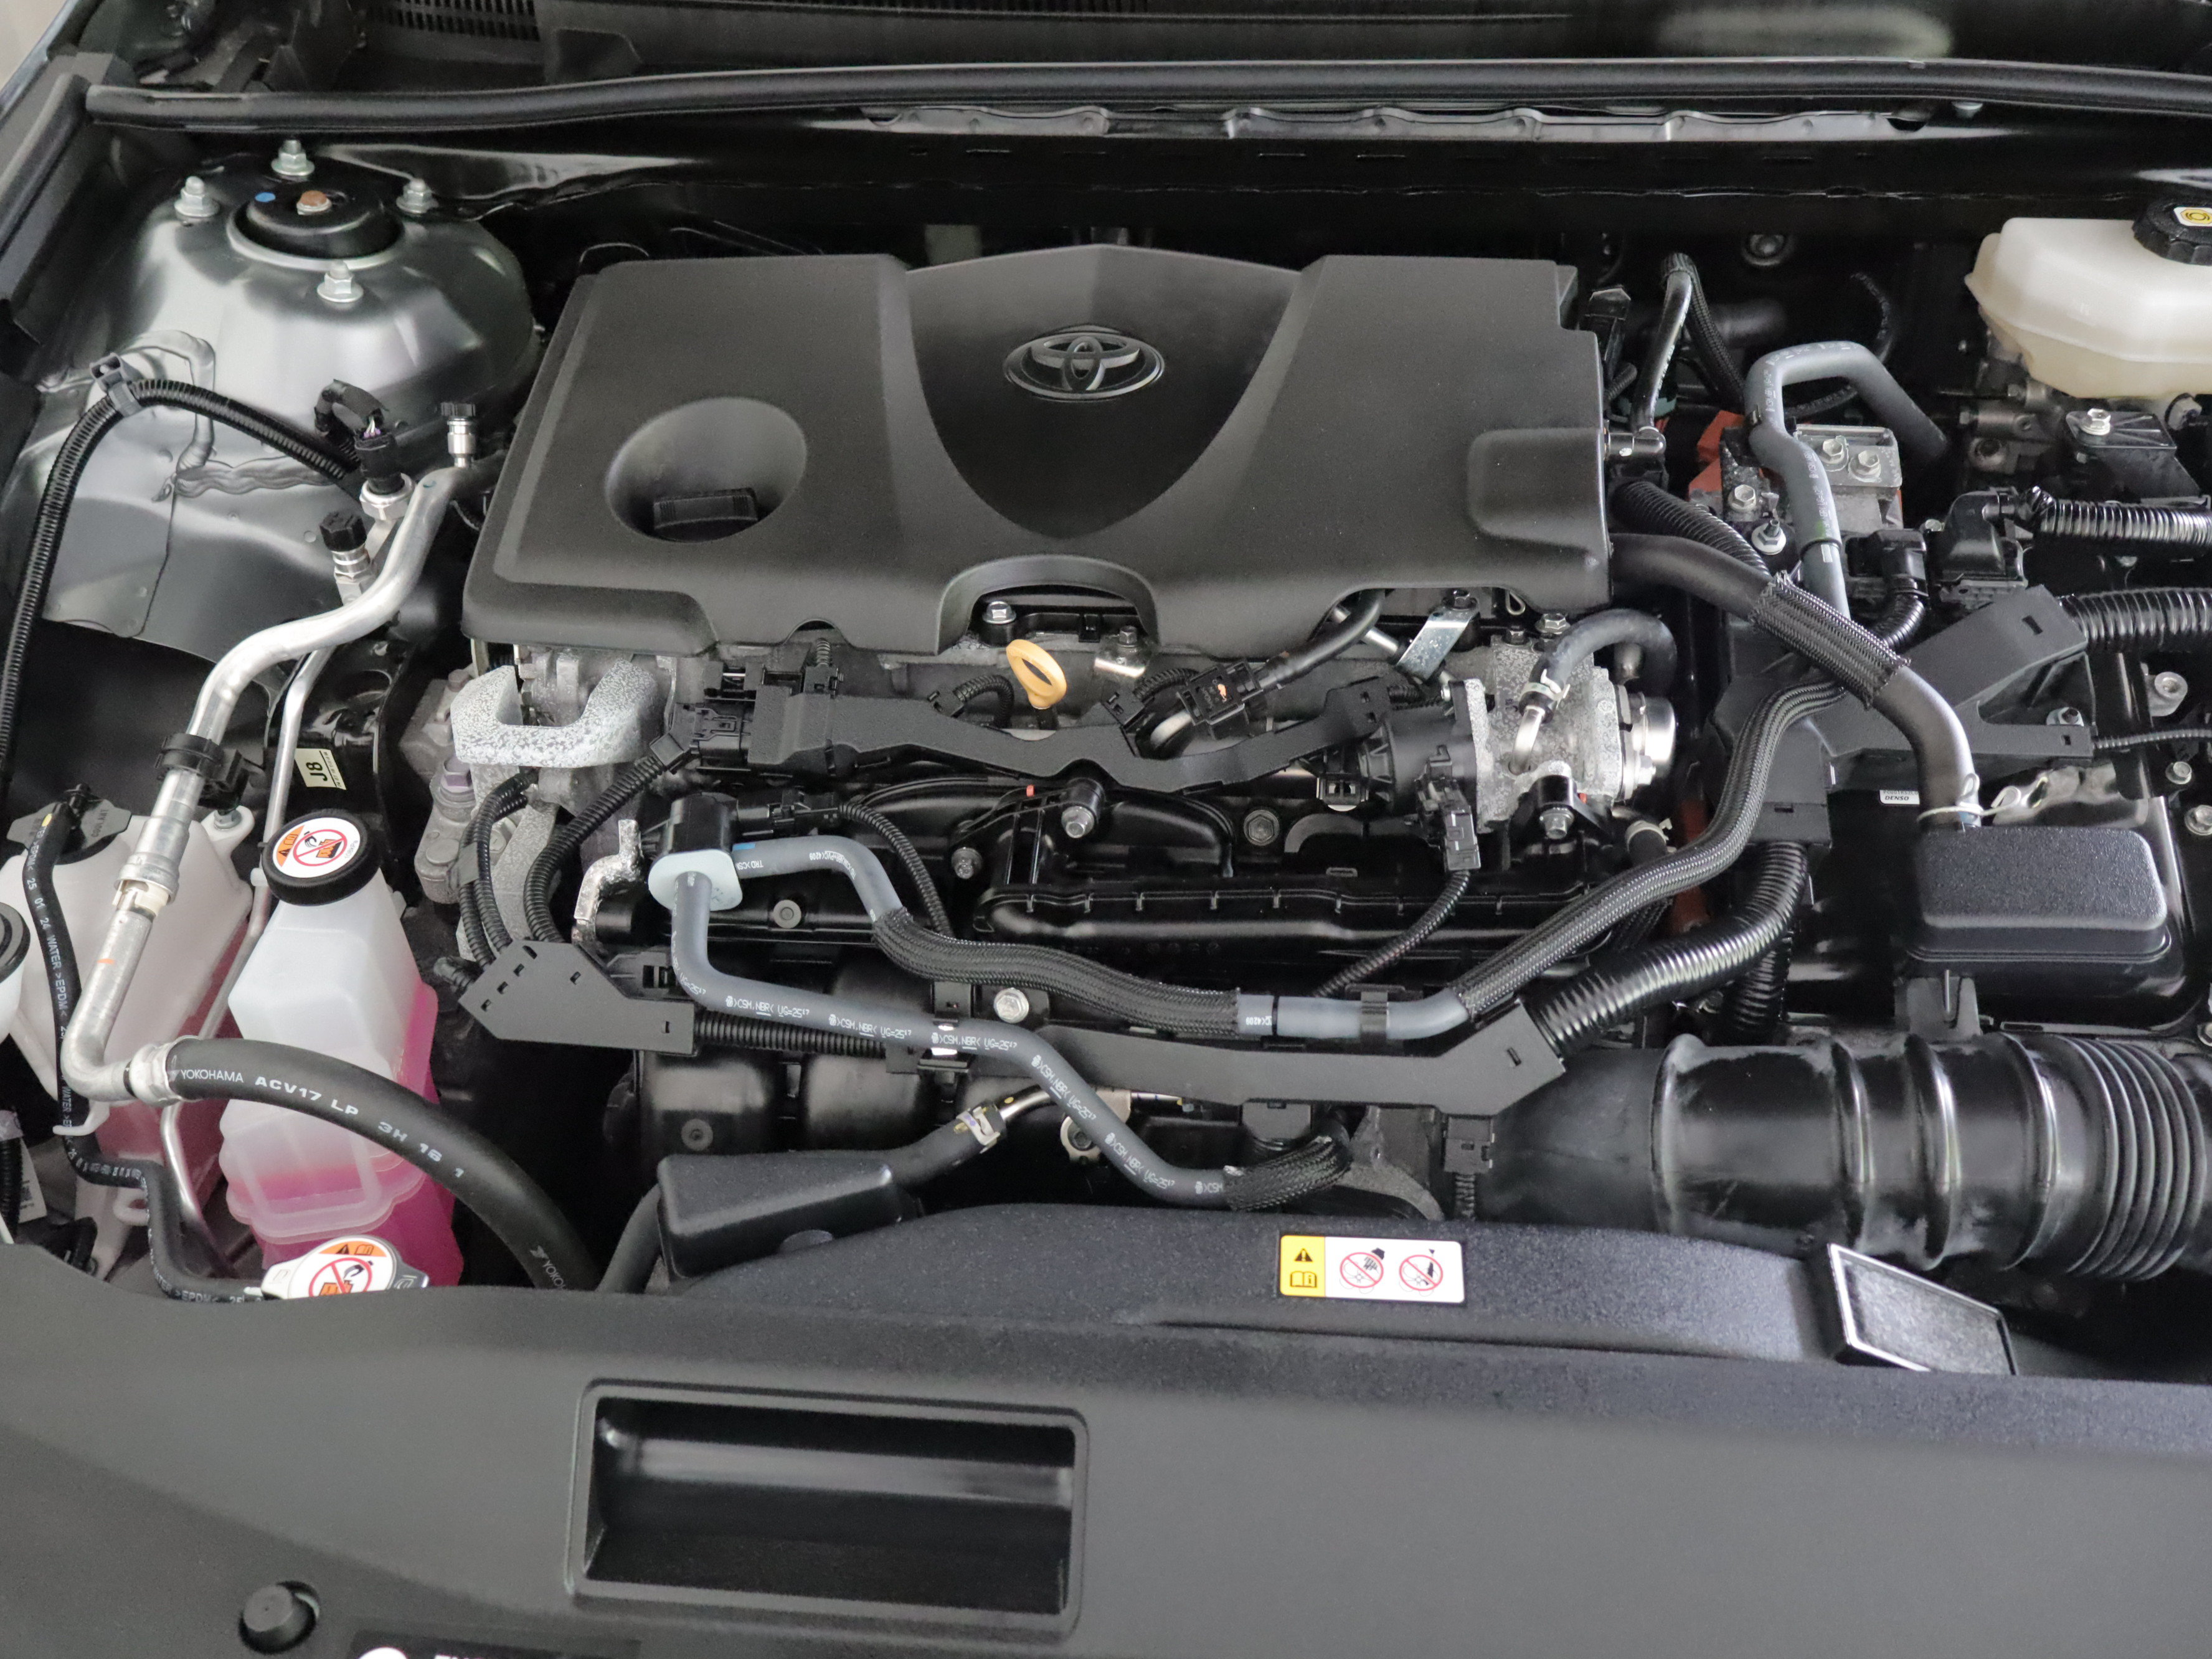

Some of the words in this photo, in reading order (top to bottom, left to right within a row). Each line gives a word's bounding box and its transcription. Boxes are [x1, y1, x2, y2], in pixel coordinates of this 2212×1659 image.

[306, 762, 328, 782] J8
[27, 878, 37, 891] 25
[34, 897, 45, 909] 01
[40, 917, 51, 930] 24
[47, 935, 61, 970] WATER
[180, 1069, 244, 1083] YOKOHAMA
[255, 1076, 323, 1101] ACV17
[330, 1099, 359, 1116] LP
[377, 1122, 409, 1141] 3H
[453, 1168, 465, 1179] 1
